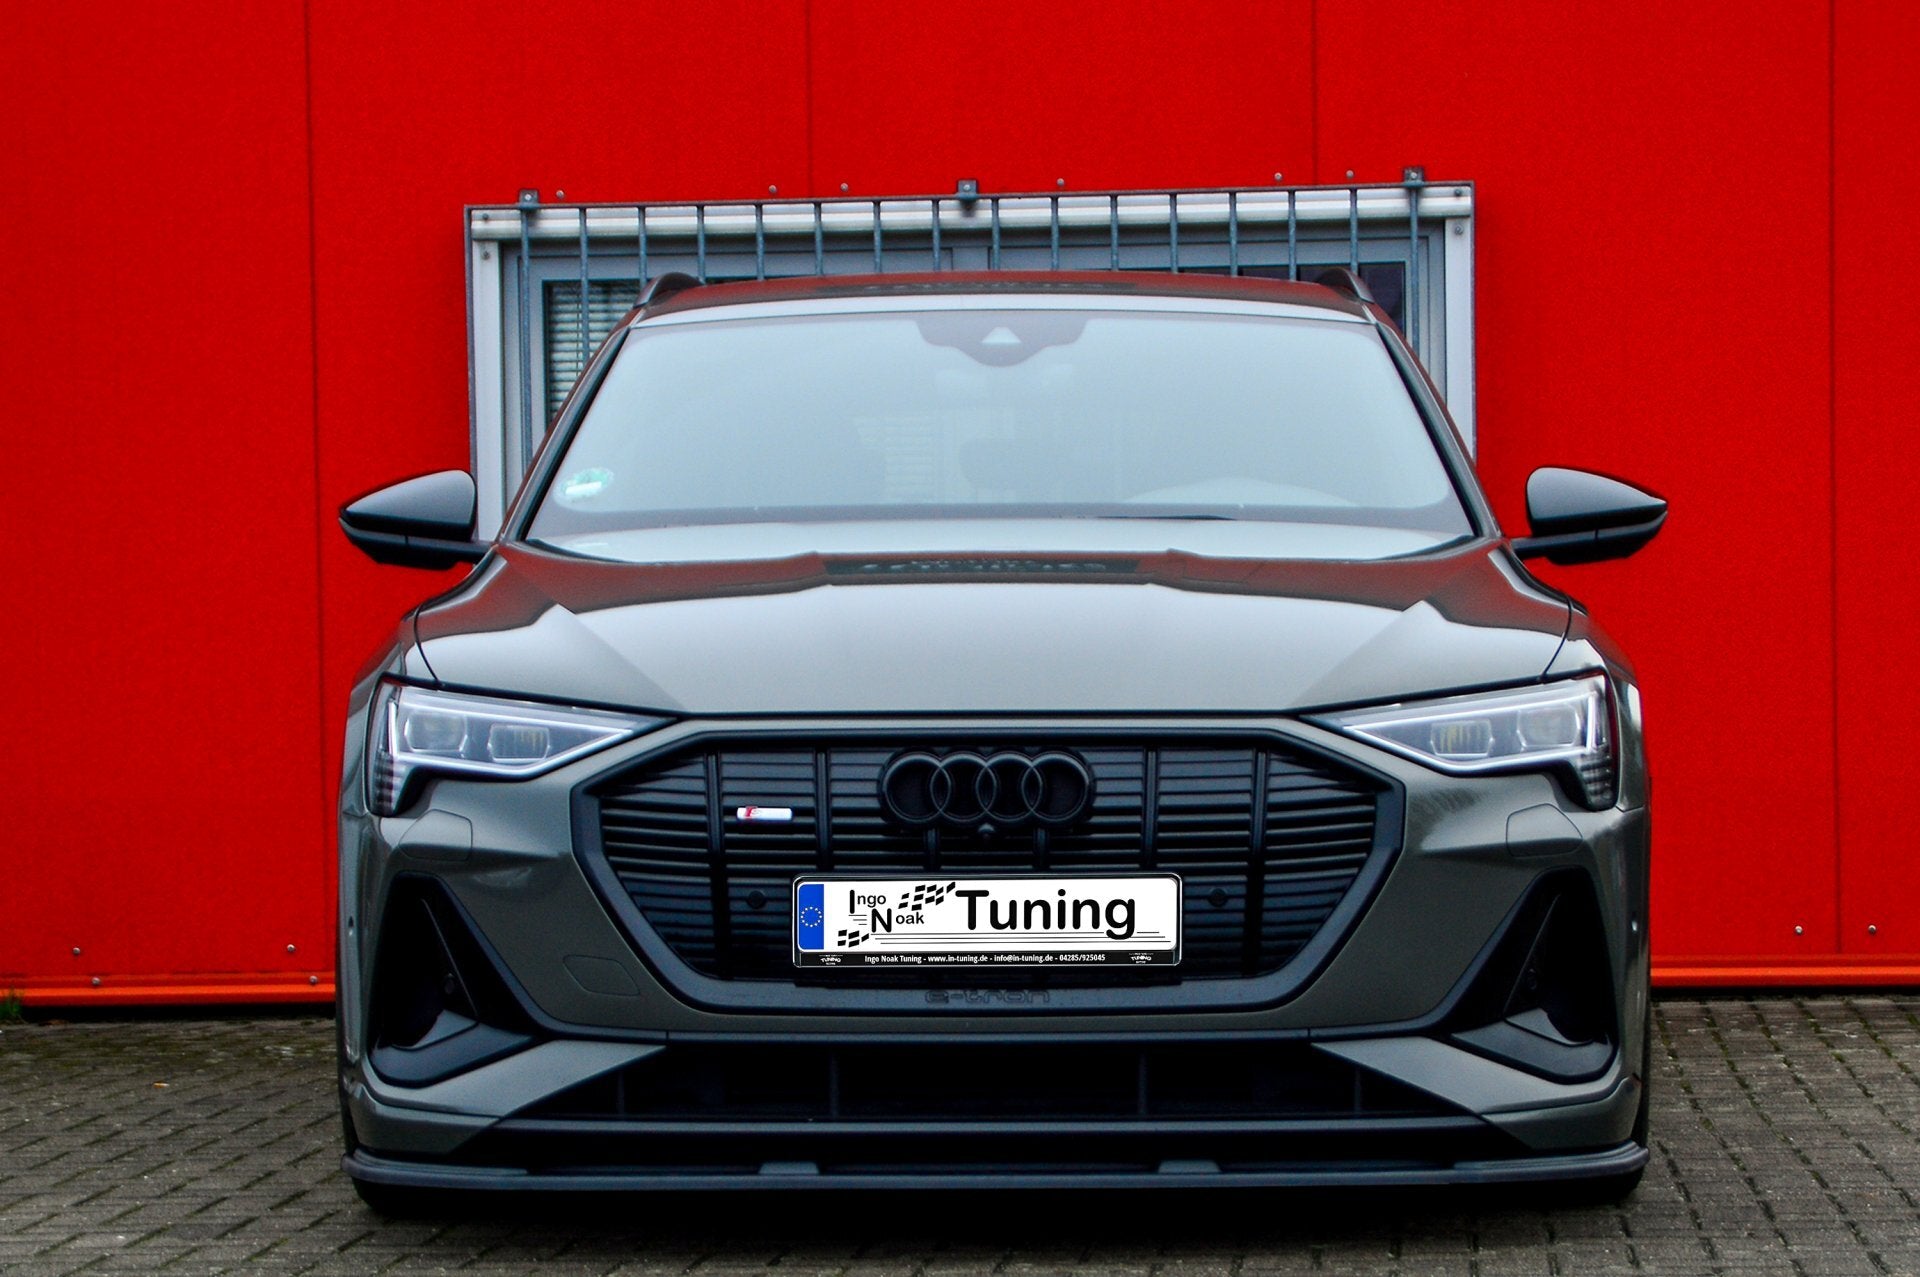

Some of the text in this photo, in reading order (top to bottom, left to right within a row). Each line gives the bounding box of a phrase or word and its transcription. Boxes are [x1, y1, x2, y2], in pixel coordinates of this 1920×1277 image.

[850, 889, 887, 914] Ingo
[871, 908, 924, 933] Noak
[955, 889, 1135, 940] Tuning
[864, 954, 880, 965] Ingo
[881, 954, 899, 962] Noak
[900, 954, 922, 964] Tuning
[928, 954, 988, 964] www.in-tuning.de
[994, 953, 1054, 963] info@in-tuning.de
[1059, 953, 1106, 962] 04285/925045
[924, 990, 1050, 1004] e-tron
